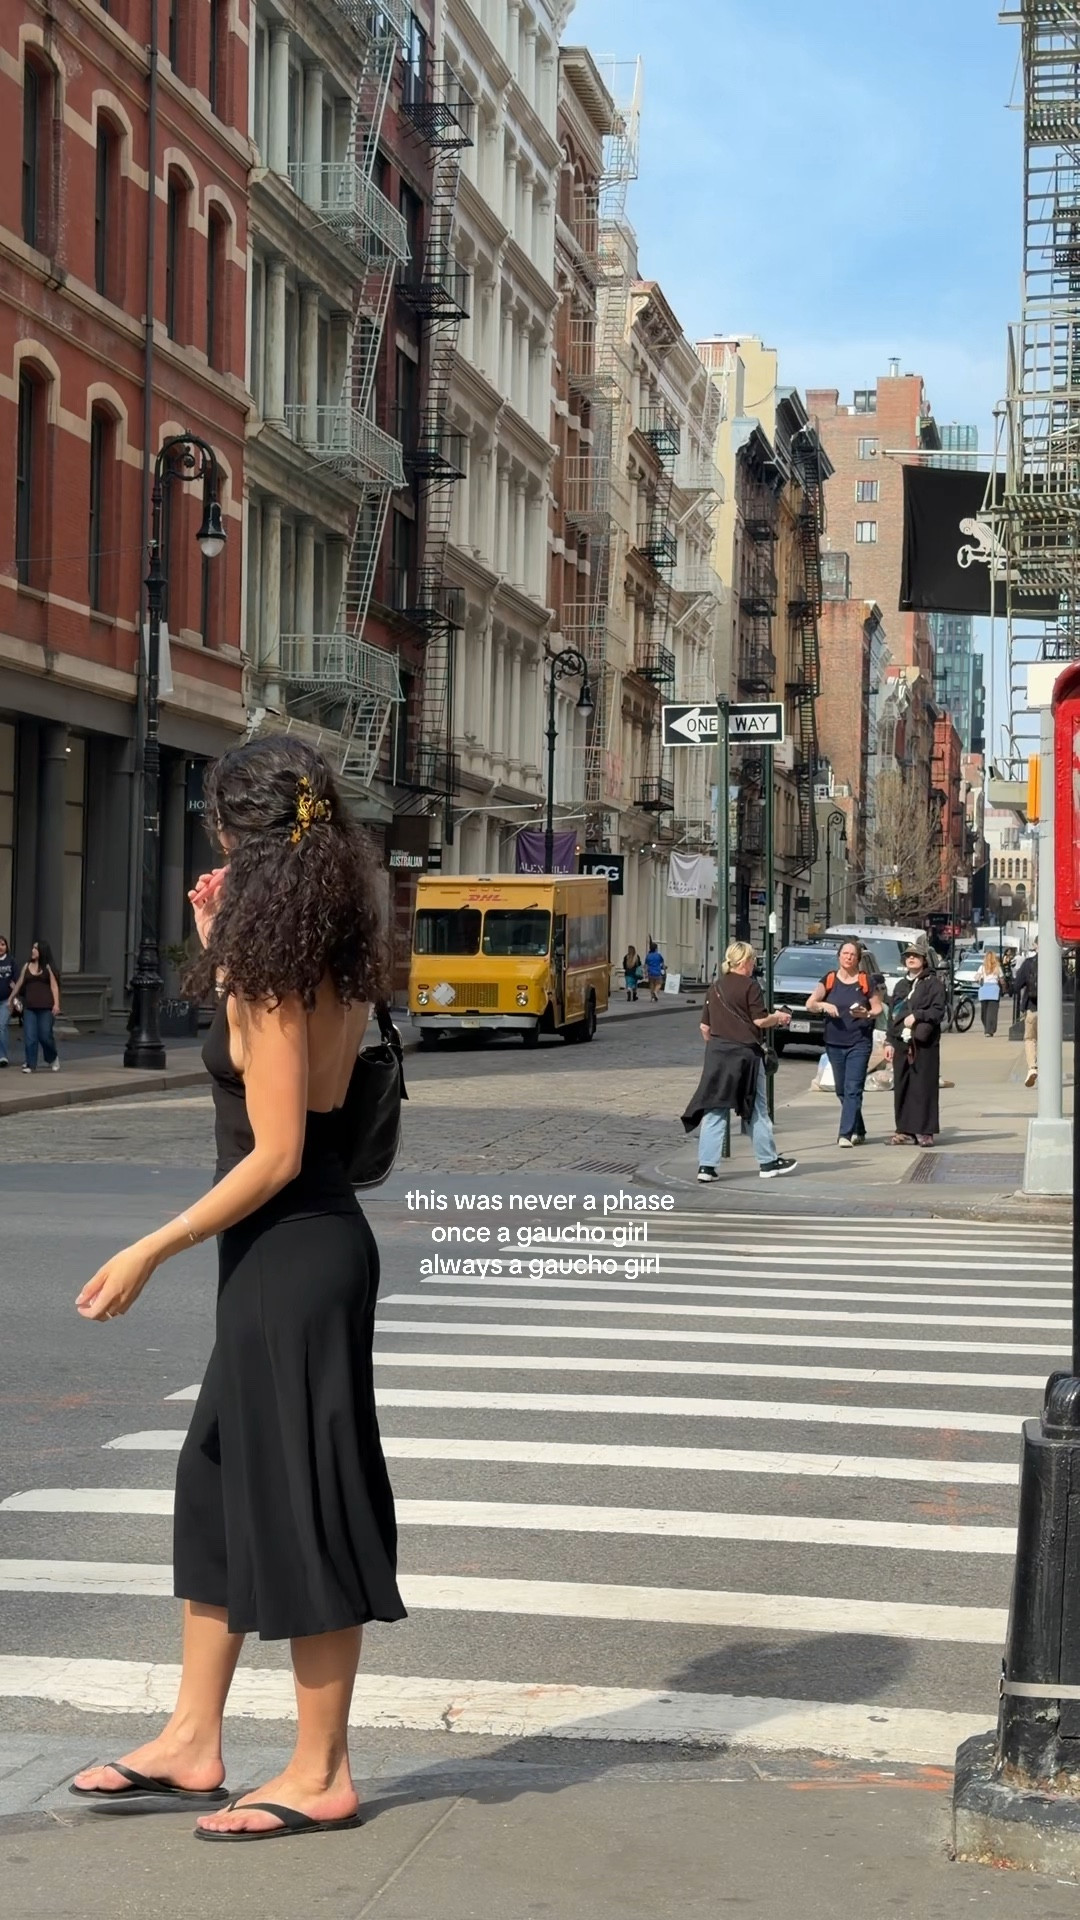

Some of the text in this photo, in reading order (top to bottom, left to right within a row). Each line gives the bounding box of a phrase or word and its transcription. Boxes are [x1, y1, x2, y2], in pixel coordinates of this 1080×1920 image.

[686, 716, 769, 733] ONE WAY
[389, 855, 423, 867] AUSTRALIAN
[519, 862, 544, 874] ALEX
[468, 894, 502, 902] DHL
